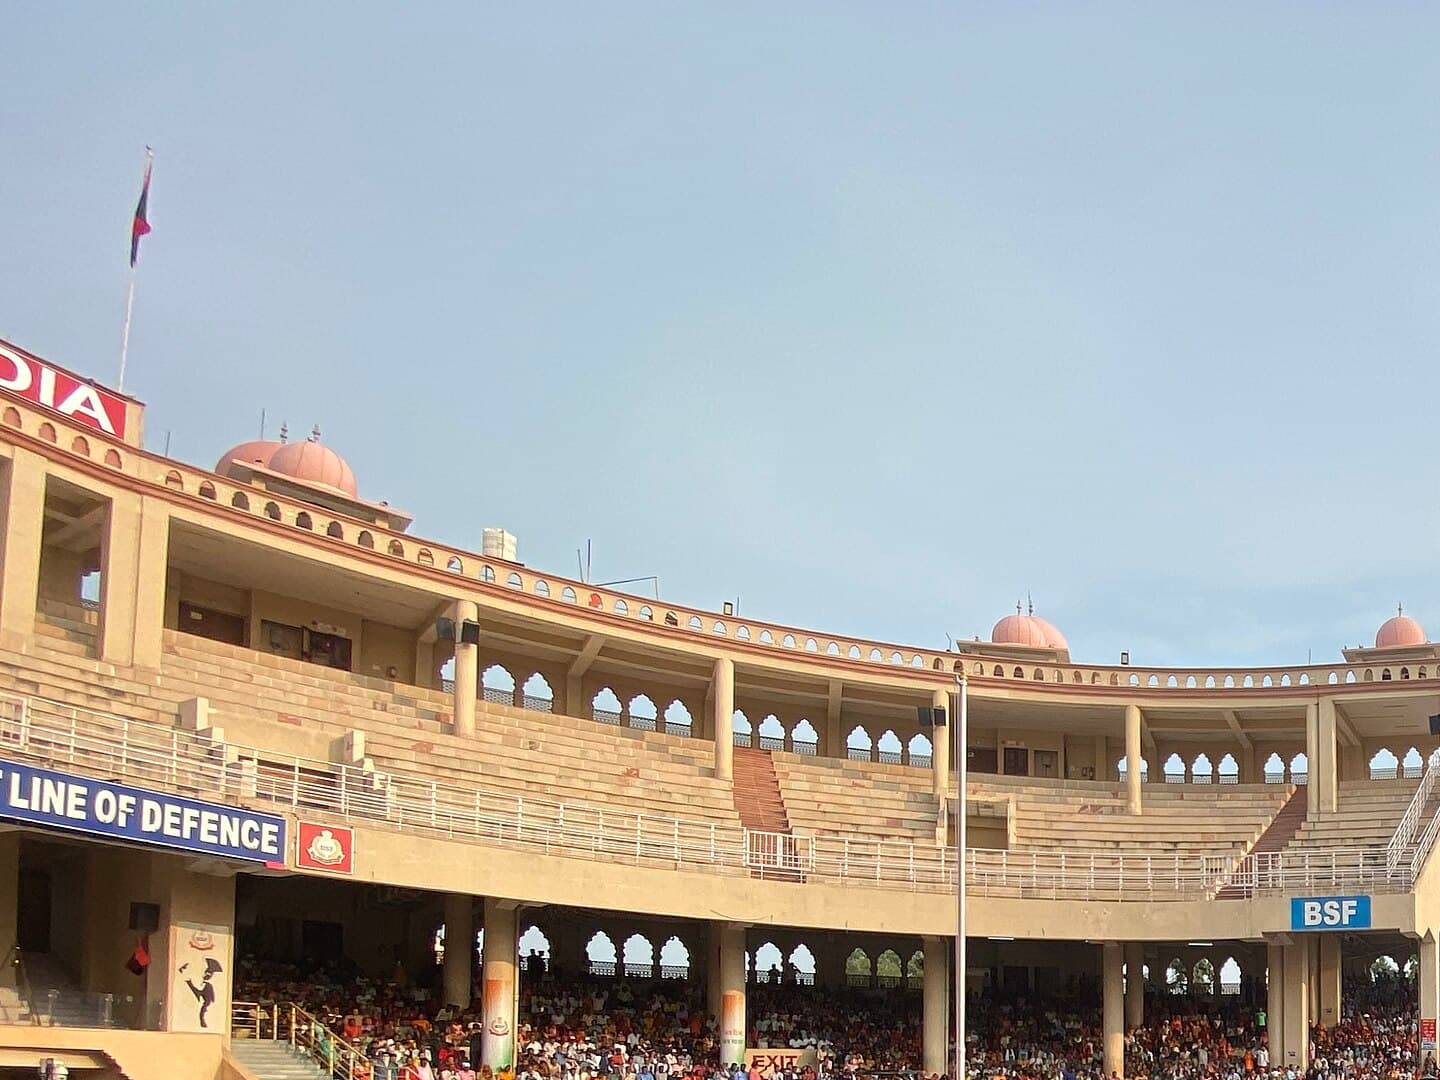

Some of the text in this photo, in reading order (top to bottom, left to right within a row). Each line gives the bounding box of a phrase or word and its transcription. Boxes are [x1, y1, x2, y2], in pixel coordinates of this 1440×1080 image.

[9, 772, 279, 855] LINE OF DEFENCE
[1304, 900, 1357, 926] BSF
[752, 1055, 798, 1071] EXIT
